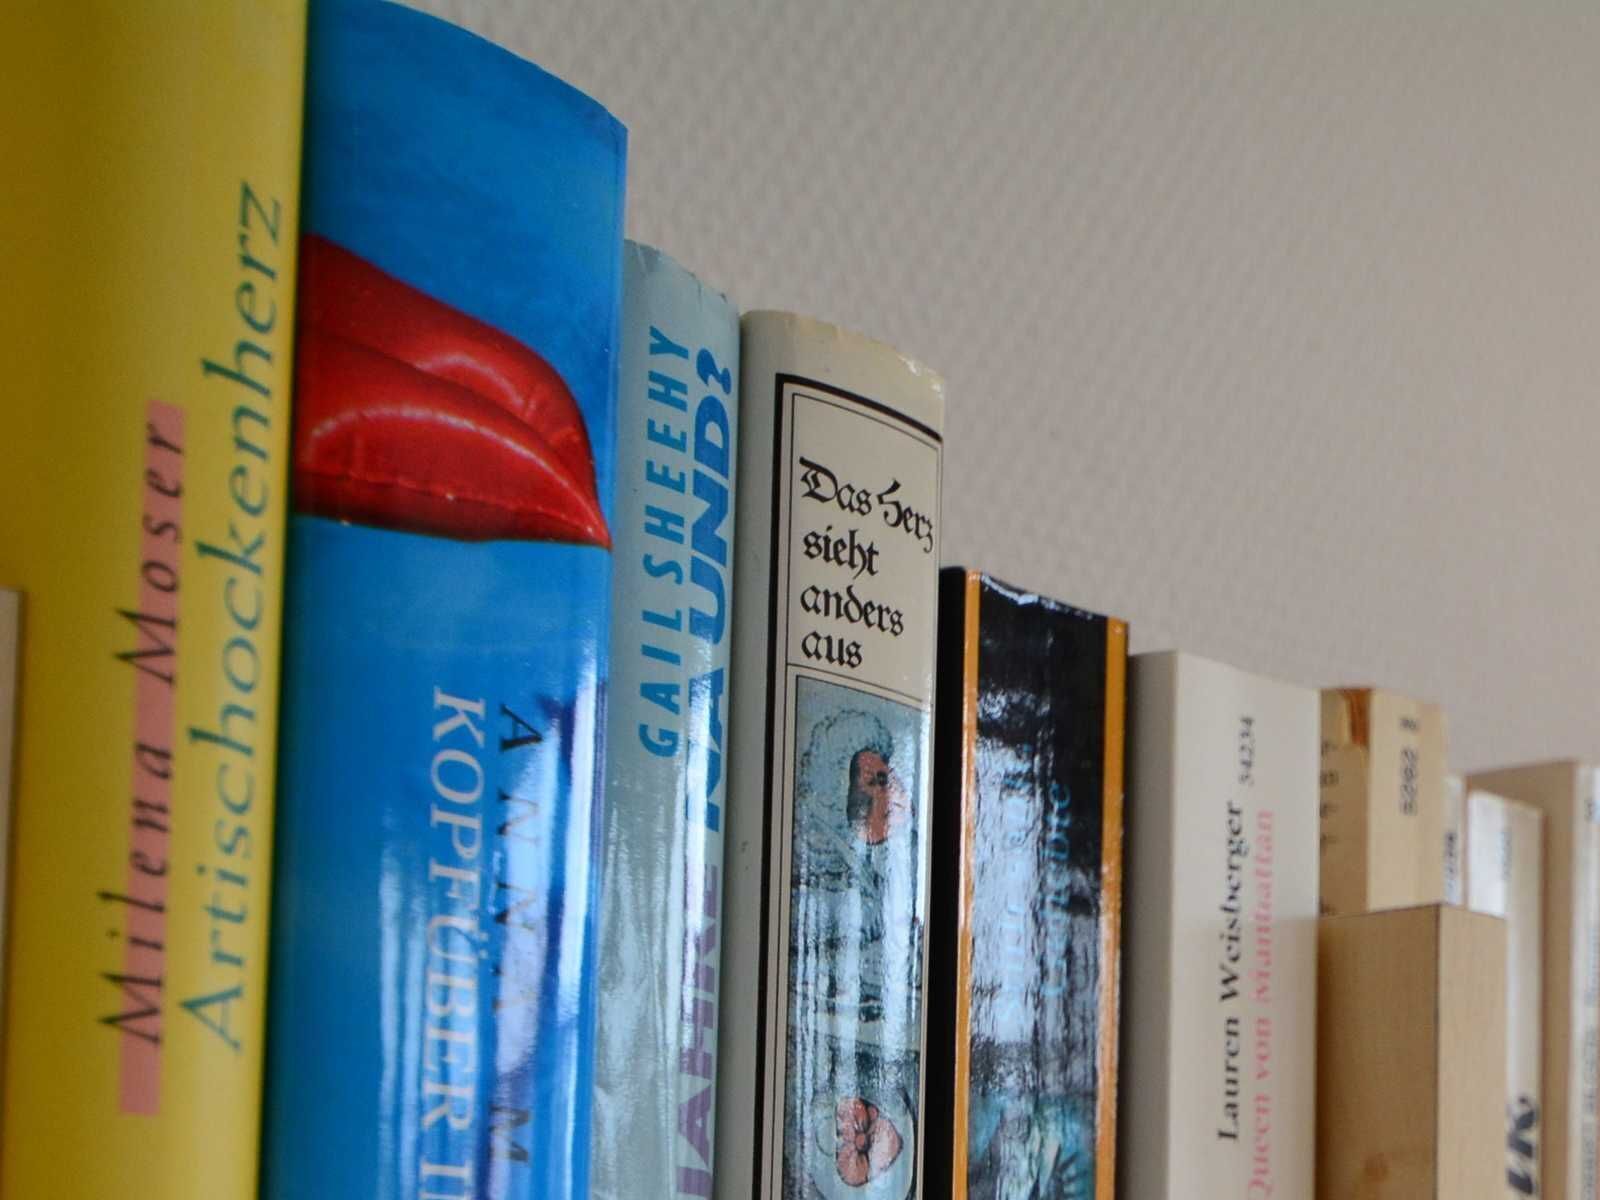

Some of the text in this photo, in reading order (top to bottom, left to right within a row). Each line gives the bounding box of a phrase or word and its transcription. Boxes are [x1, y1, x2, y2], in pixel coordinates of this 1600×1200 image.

[177, 180, 283, 1053] Artischockenherz
[637, 323, 691, 759] GAIL SHEEHY
[688, 346, 733, 646] UND?
[798, 455, 873, 517] Das
[799, 583, 905, 638] anders
[802, 524, 880, 581] sieht
[97, 422, 184, 1047] Milena Moser
[800, 629, 863, 669] aus
[419, 684, 490, 1133] KOPFÜBER
[490, 702, 543, 1013] ANN
[1217, 800, 1250, 1142] Lauren Weisberger
[1253, 1016, 1272, 1082] von
